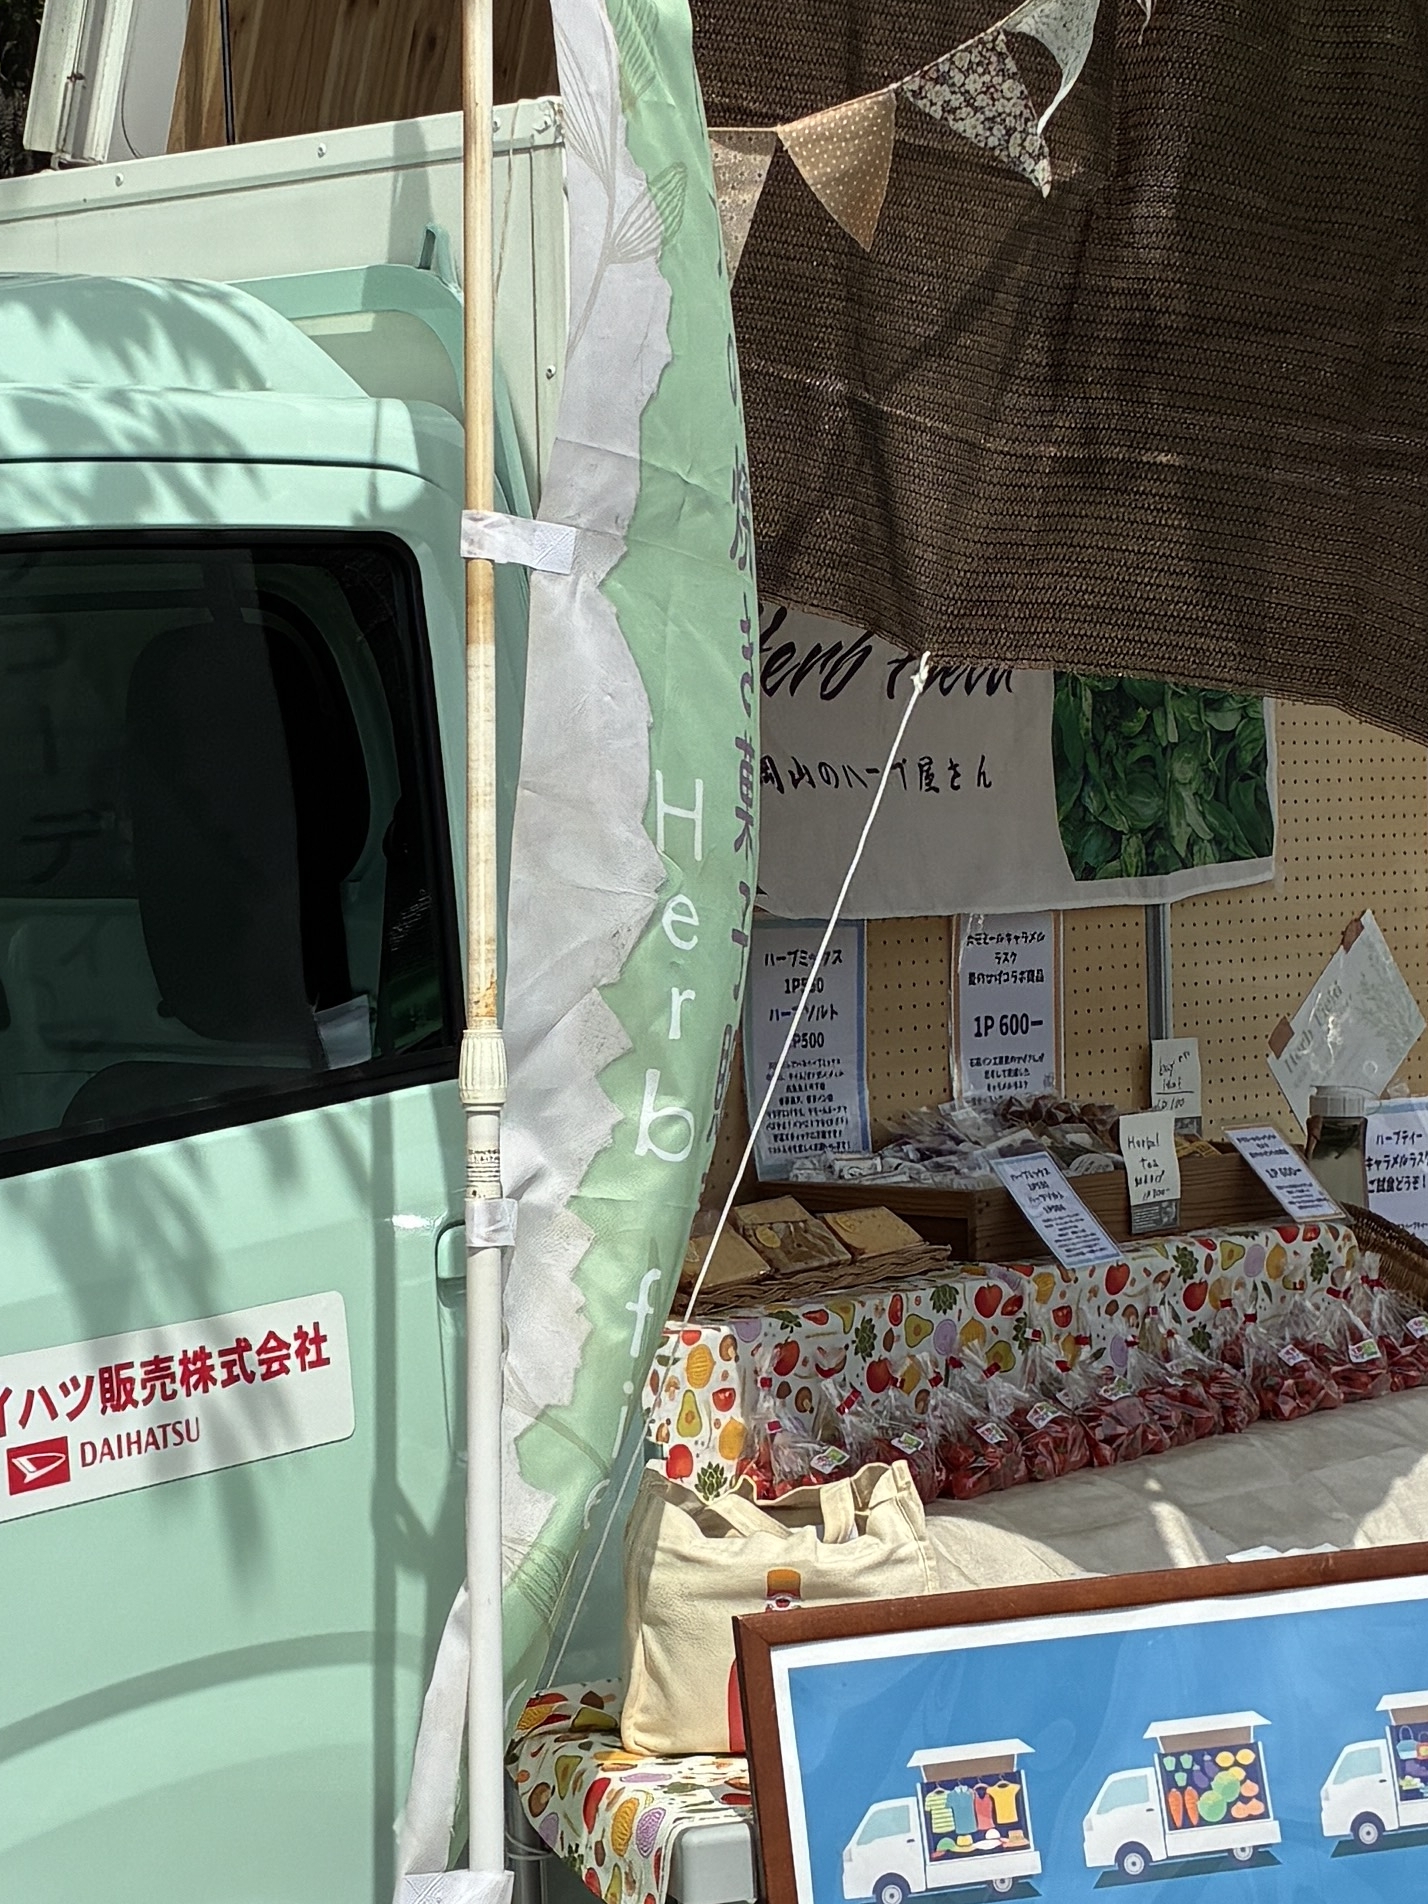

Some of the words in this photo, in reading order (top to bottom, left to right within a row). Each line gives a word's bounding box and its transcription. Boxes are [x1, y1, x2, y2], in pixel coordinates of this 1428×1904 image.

[634, 768, 704, 1163] Herb
[995, 951, 1018, 965] ラスク
[974, 1015, 995, 1038] 1P
[790, 1031, 825, 1050] P500
[1376, 1130, 1423, 1145] ハーブティー
[80, 1416, 201, 1469] DAIHATSU
